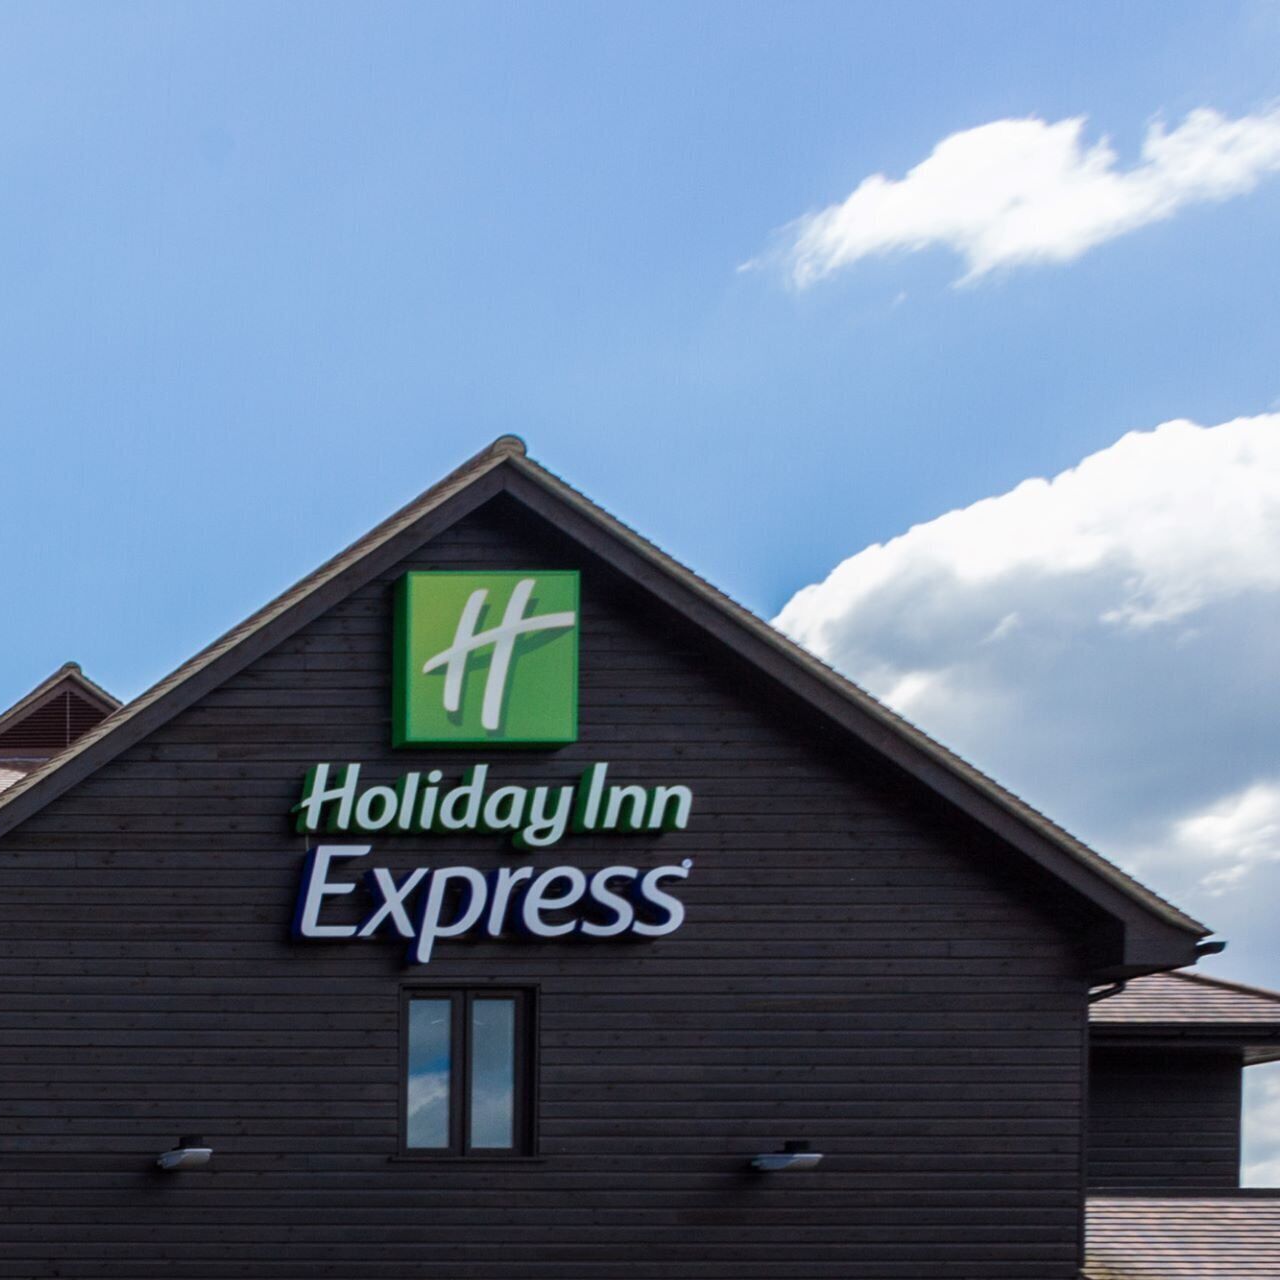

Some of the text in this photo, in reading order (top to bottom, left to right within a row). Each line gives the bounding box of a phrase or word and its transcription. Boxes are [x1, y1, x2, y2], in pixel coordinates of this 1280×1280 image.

[422, 578, 576, 731] H
[300, 763, 693, 847] Holiday Inn
[301, 844, 690, 964] Express
